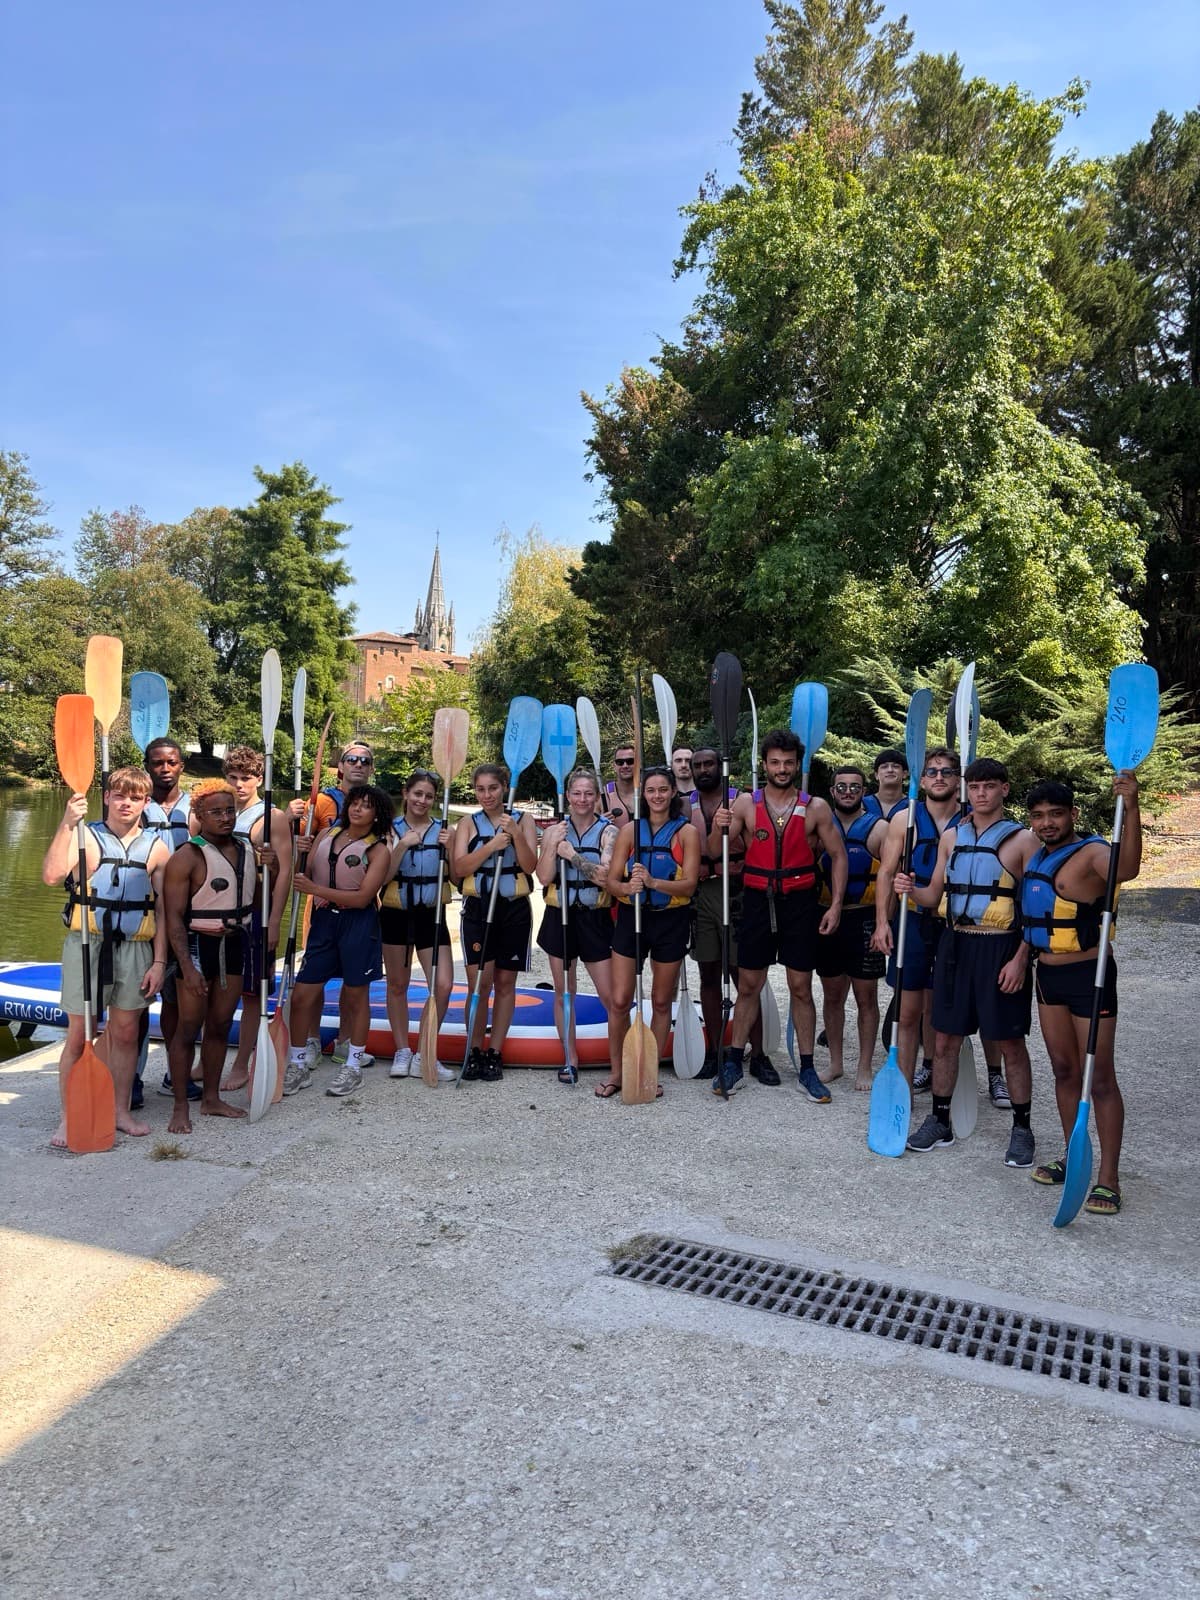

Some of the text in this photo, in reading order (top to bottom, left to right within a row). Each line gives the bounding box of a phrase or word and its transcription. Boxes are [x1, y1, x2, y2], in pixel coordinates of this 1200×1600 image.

[1110, 696, 1127, 724] 210
[508, 719, 519, 741] 205
[4, 1001, 63, 1021] RTM SUP
